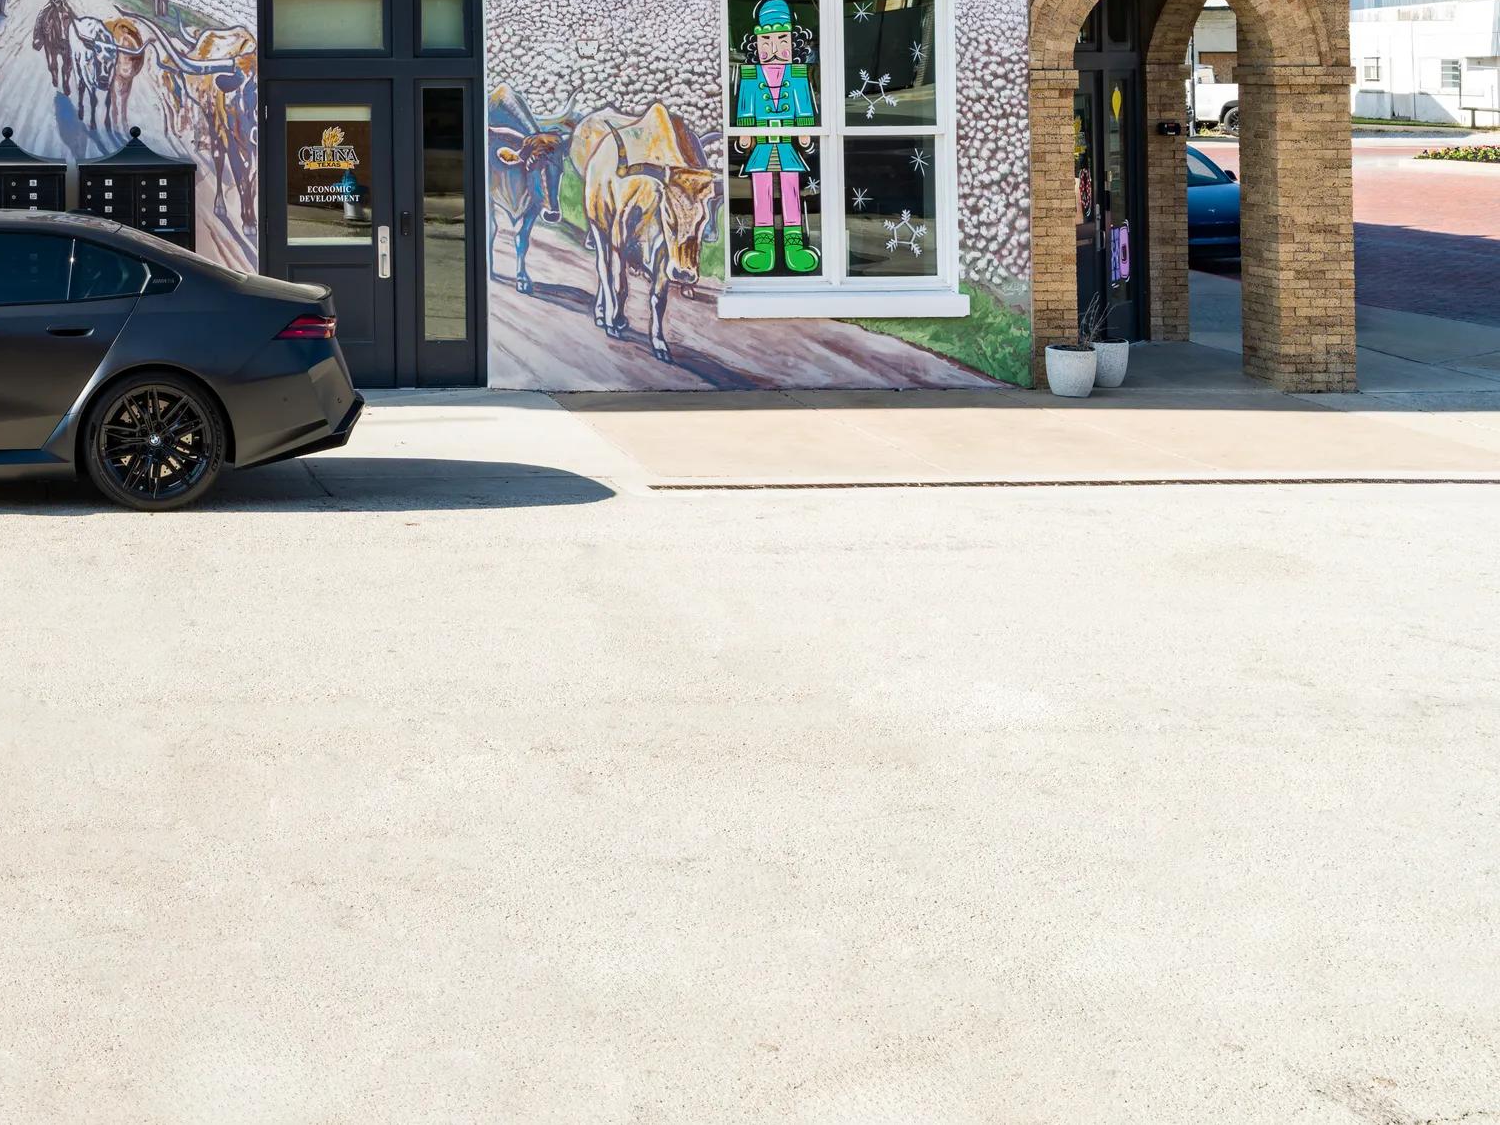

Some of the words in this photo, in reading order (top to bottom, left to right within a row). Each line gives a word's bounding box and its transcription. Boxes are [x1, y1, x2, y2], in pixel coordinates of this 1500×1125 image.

[299, 146, 358, 163] CELINA
[307, 185, 352, 193] ECONOMIC
[299, 194, 360, 202] DEVELOPMENT
